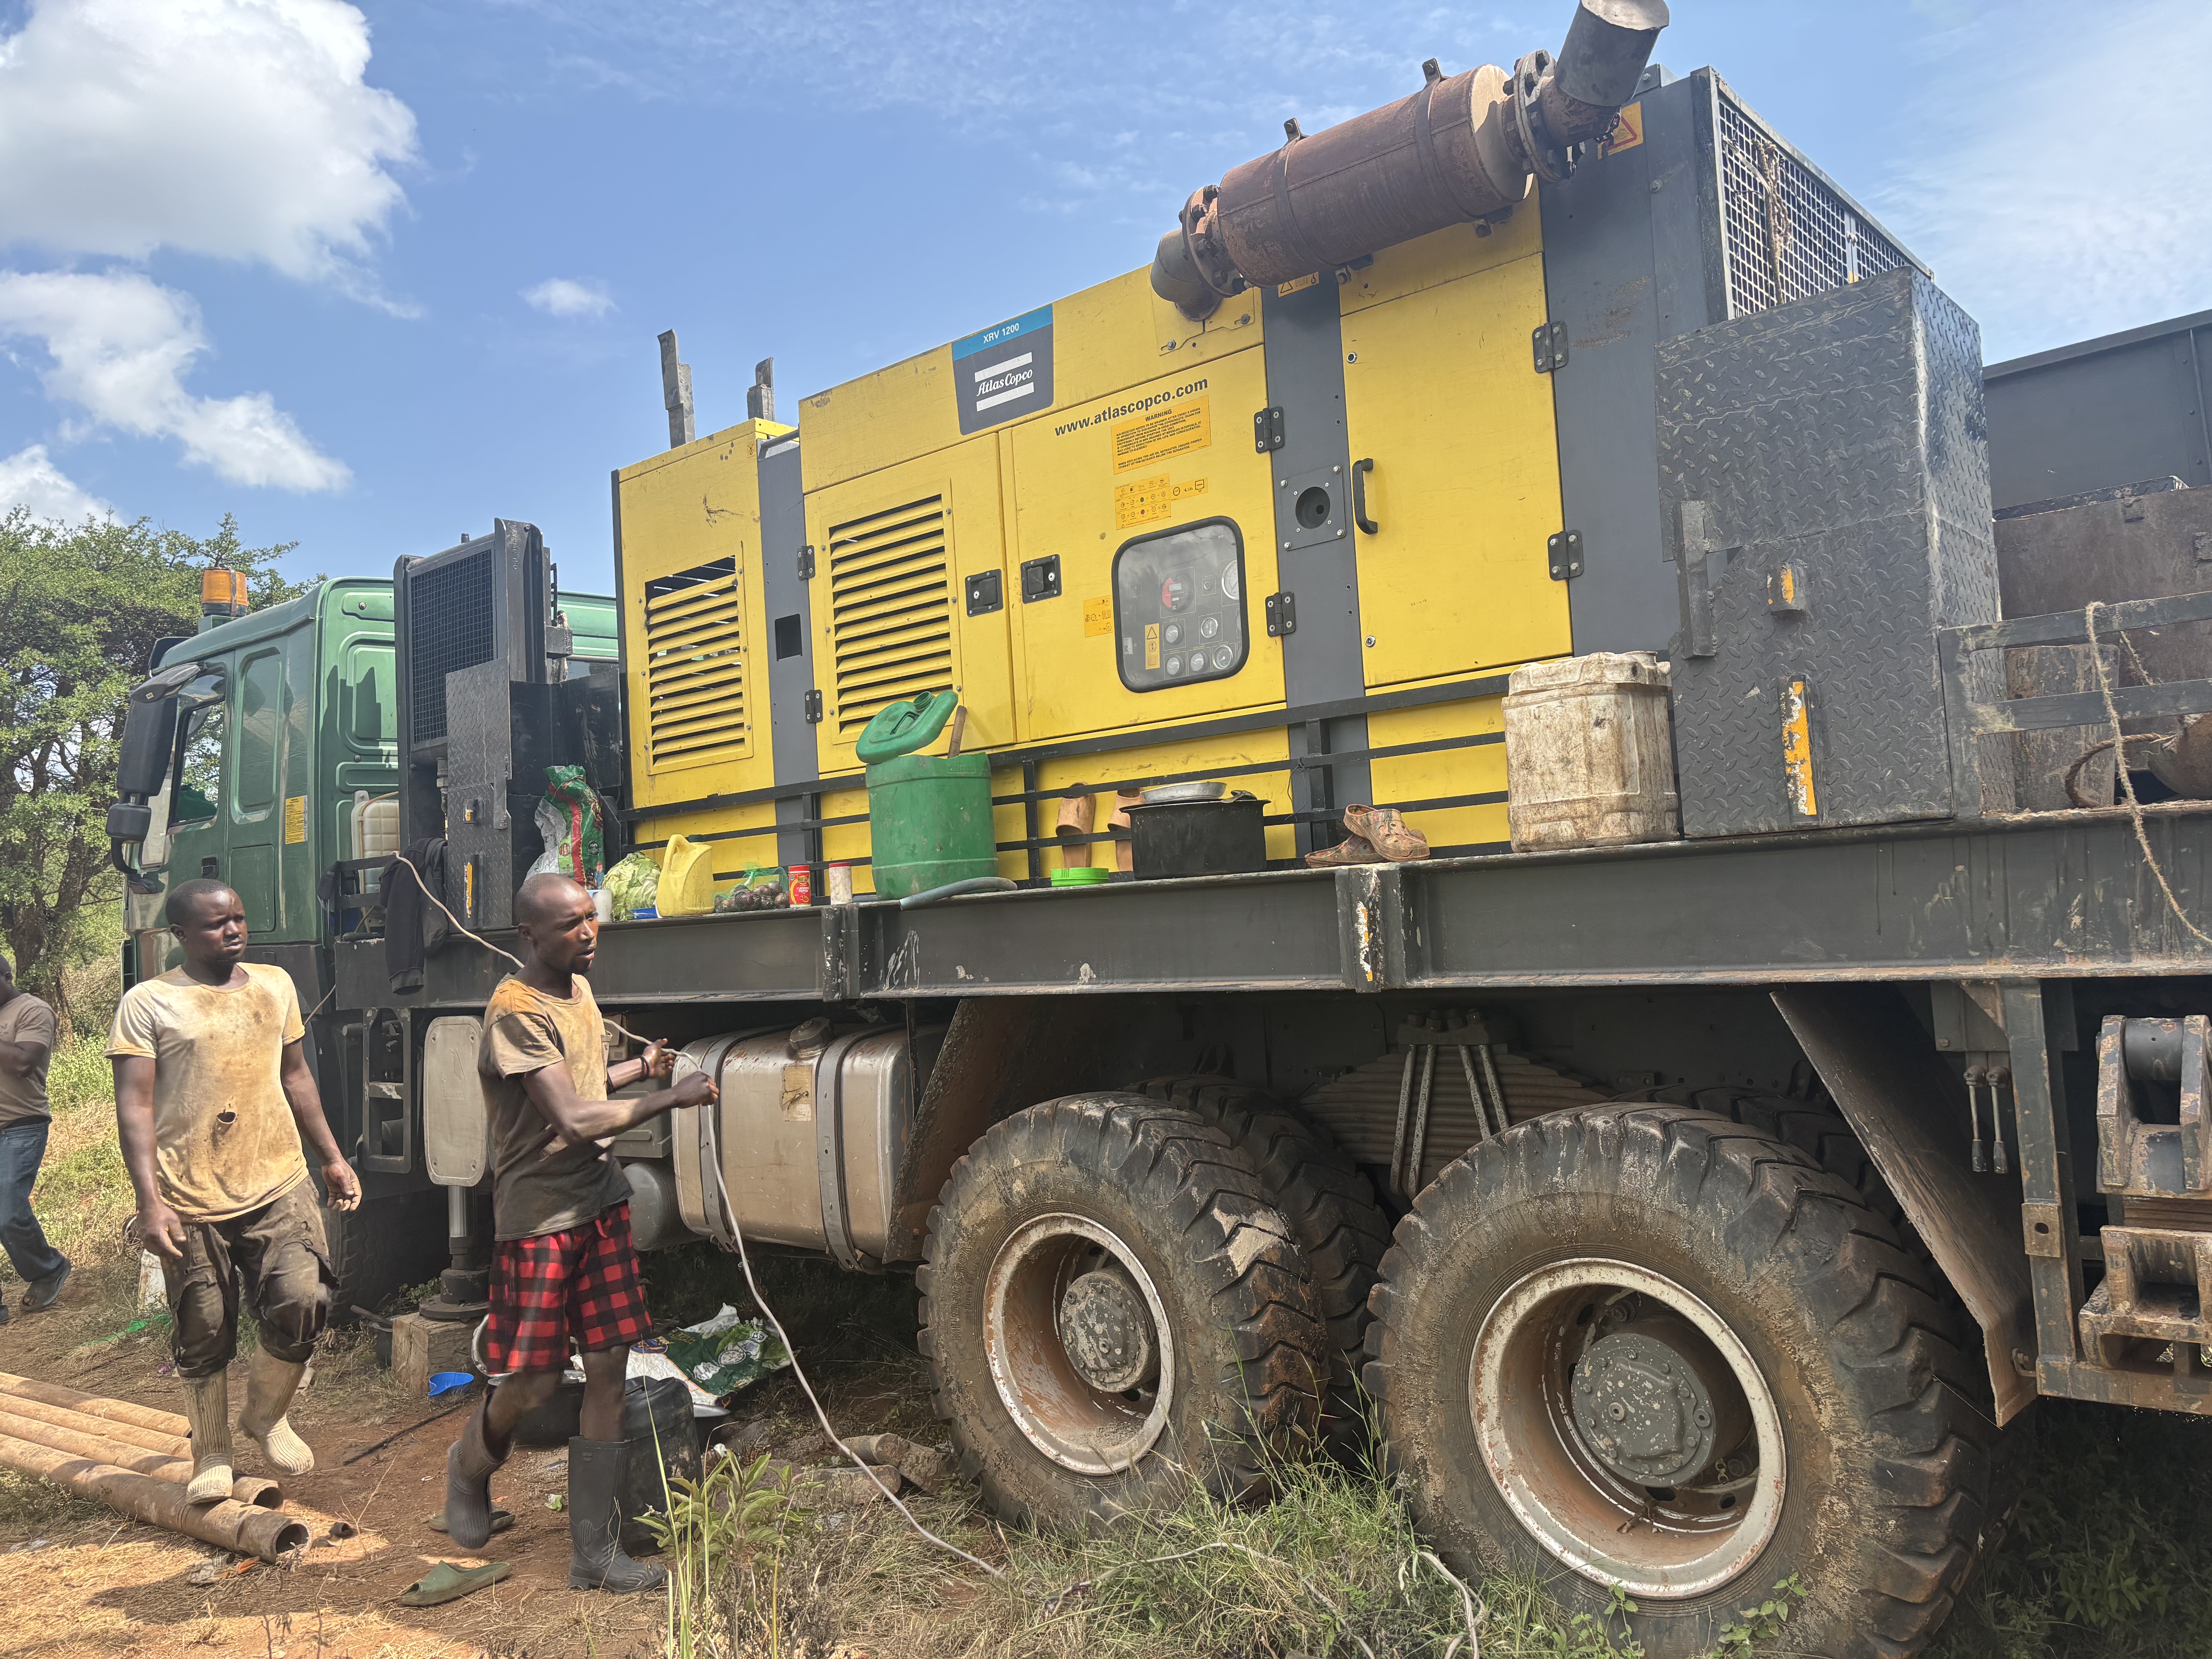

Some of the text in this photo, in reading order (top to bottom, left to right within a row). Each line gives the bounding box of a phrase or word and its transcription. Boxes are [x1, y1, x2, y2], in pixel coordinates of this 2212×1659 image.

[983, 323, 1019, 343] XRV 1200
[1054, 378, 1208, 436] www.atlascopco.com
[1145, 409, 1172, 422] WARNING
